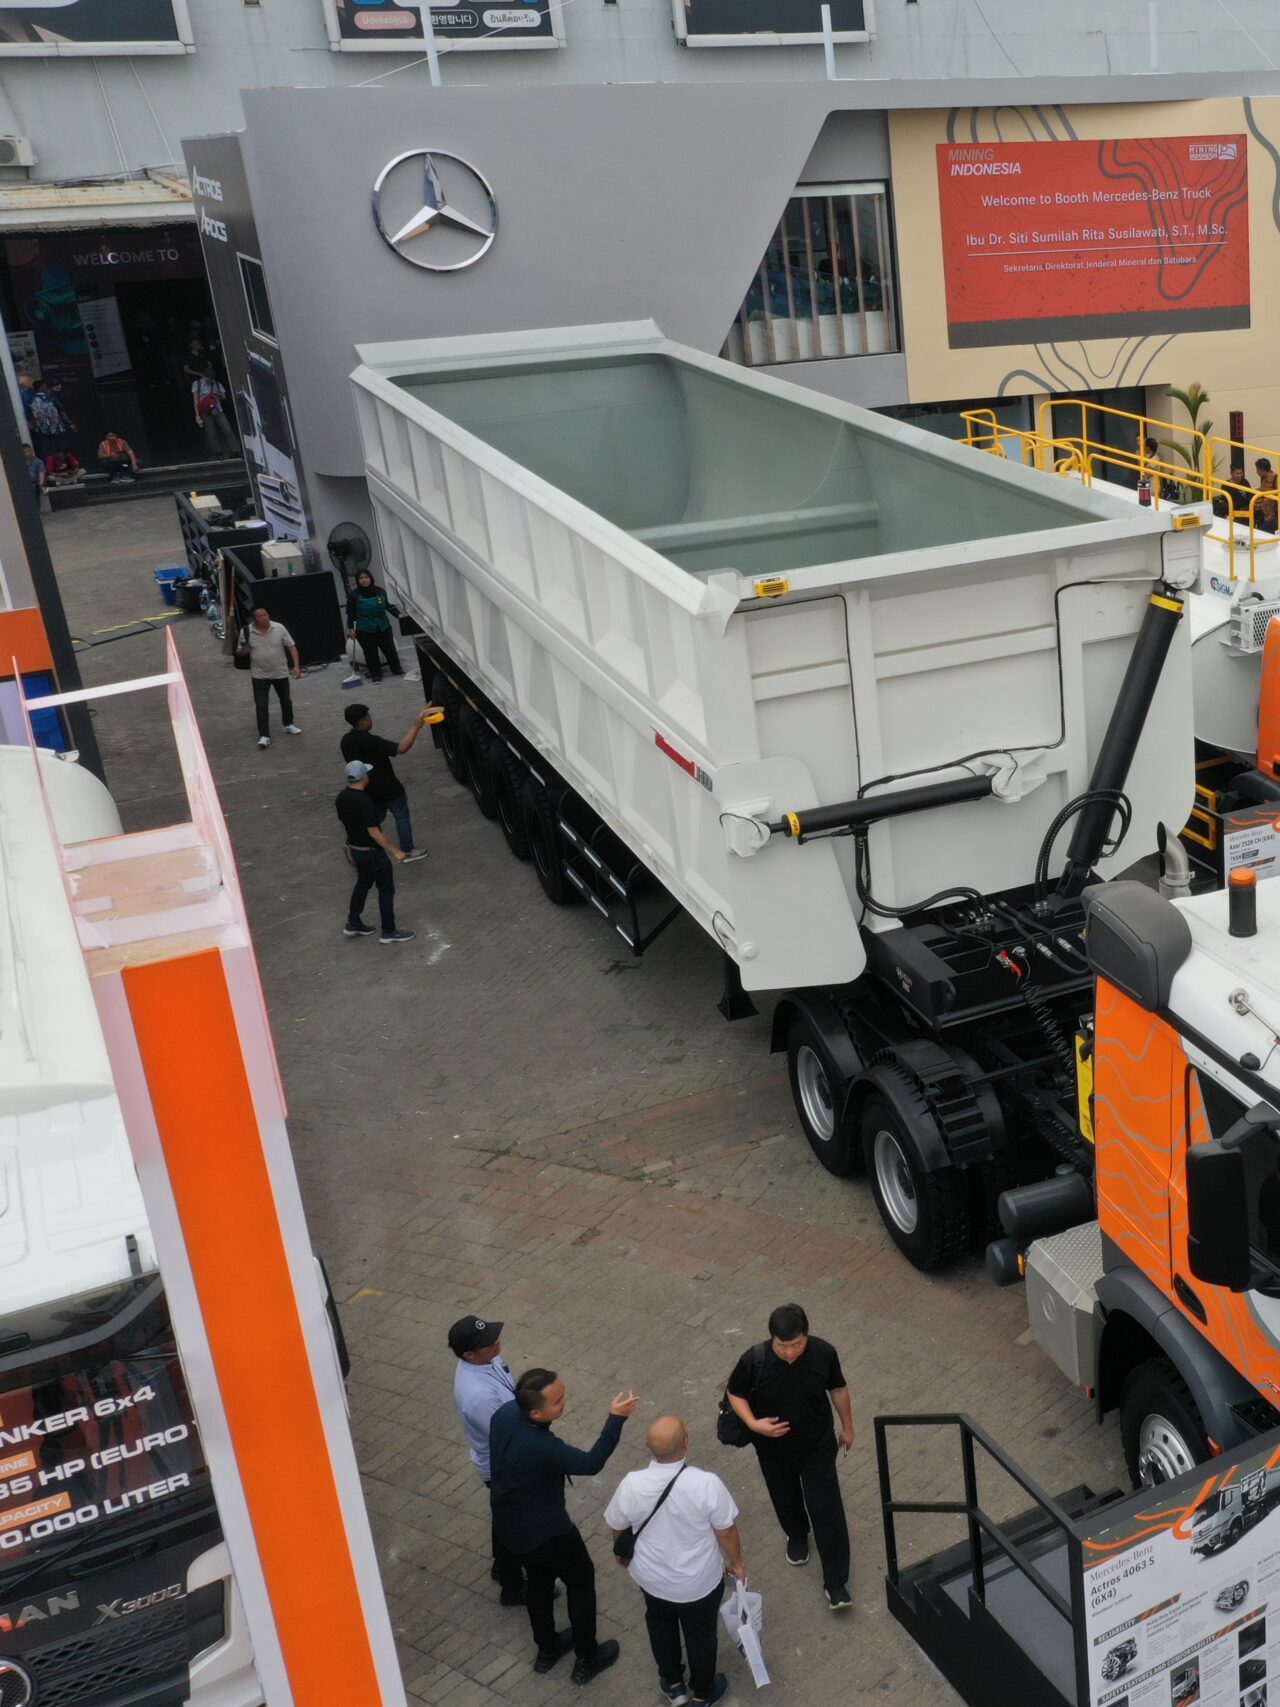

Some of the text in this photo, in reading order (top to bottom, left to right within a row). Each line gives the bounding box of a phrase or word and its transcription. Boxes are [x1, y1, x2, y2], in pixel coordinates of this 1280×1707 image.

[948, 149, 994, 161] MINING
[951, 162, 1022, 177] INDONESIA
[981, 186, 1211, 207] Welcome to Booth Mercedes-Benz Truck
[966, 223, 1228, 246] Ibu Dr. Siti Sumilah Rita Susilawati, S.T., M.Sc.
[73, 249, 180, 266] WELCOME TO
[1003, 254, 1197, 273] Sekretaris Direktorat Jenderal Mineral dan Batubara
[94, 1385, 156, 1417] 6x4
[38, 1424, 188, 1486] HP (EURO
[103, 1472, 190, 1515] LITER
[1089, 1545, 1154, 1583] Mercedes-Benz
[1091, 1555, 1155, 1597] Actros 4063 S
[91, 1583, 183, 1627] X3000
[1091, 1587, 1117, 1609] (6X4)
[1097, 1619, 1136, 1643] RELIABILITY
[1101, 1684, 1124, 1703] SAFETY
[1124, 1670, 1154, 1690] FEATURES
[1153, 1663, 1167, 1675] AND
[1166, 1634, 1217, 1667] COMFORTABILITY
